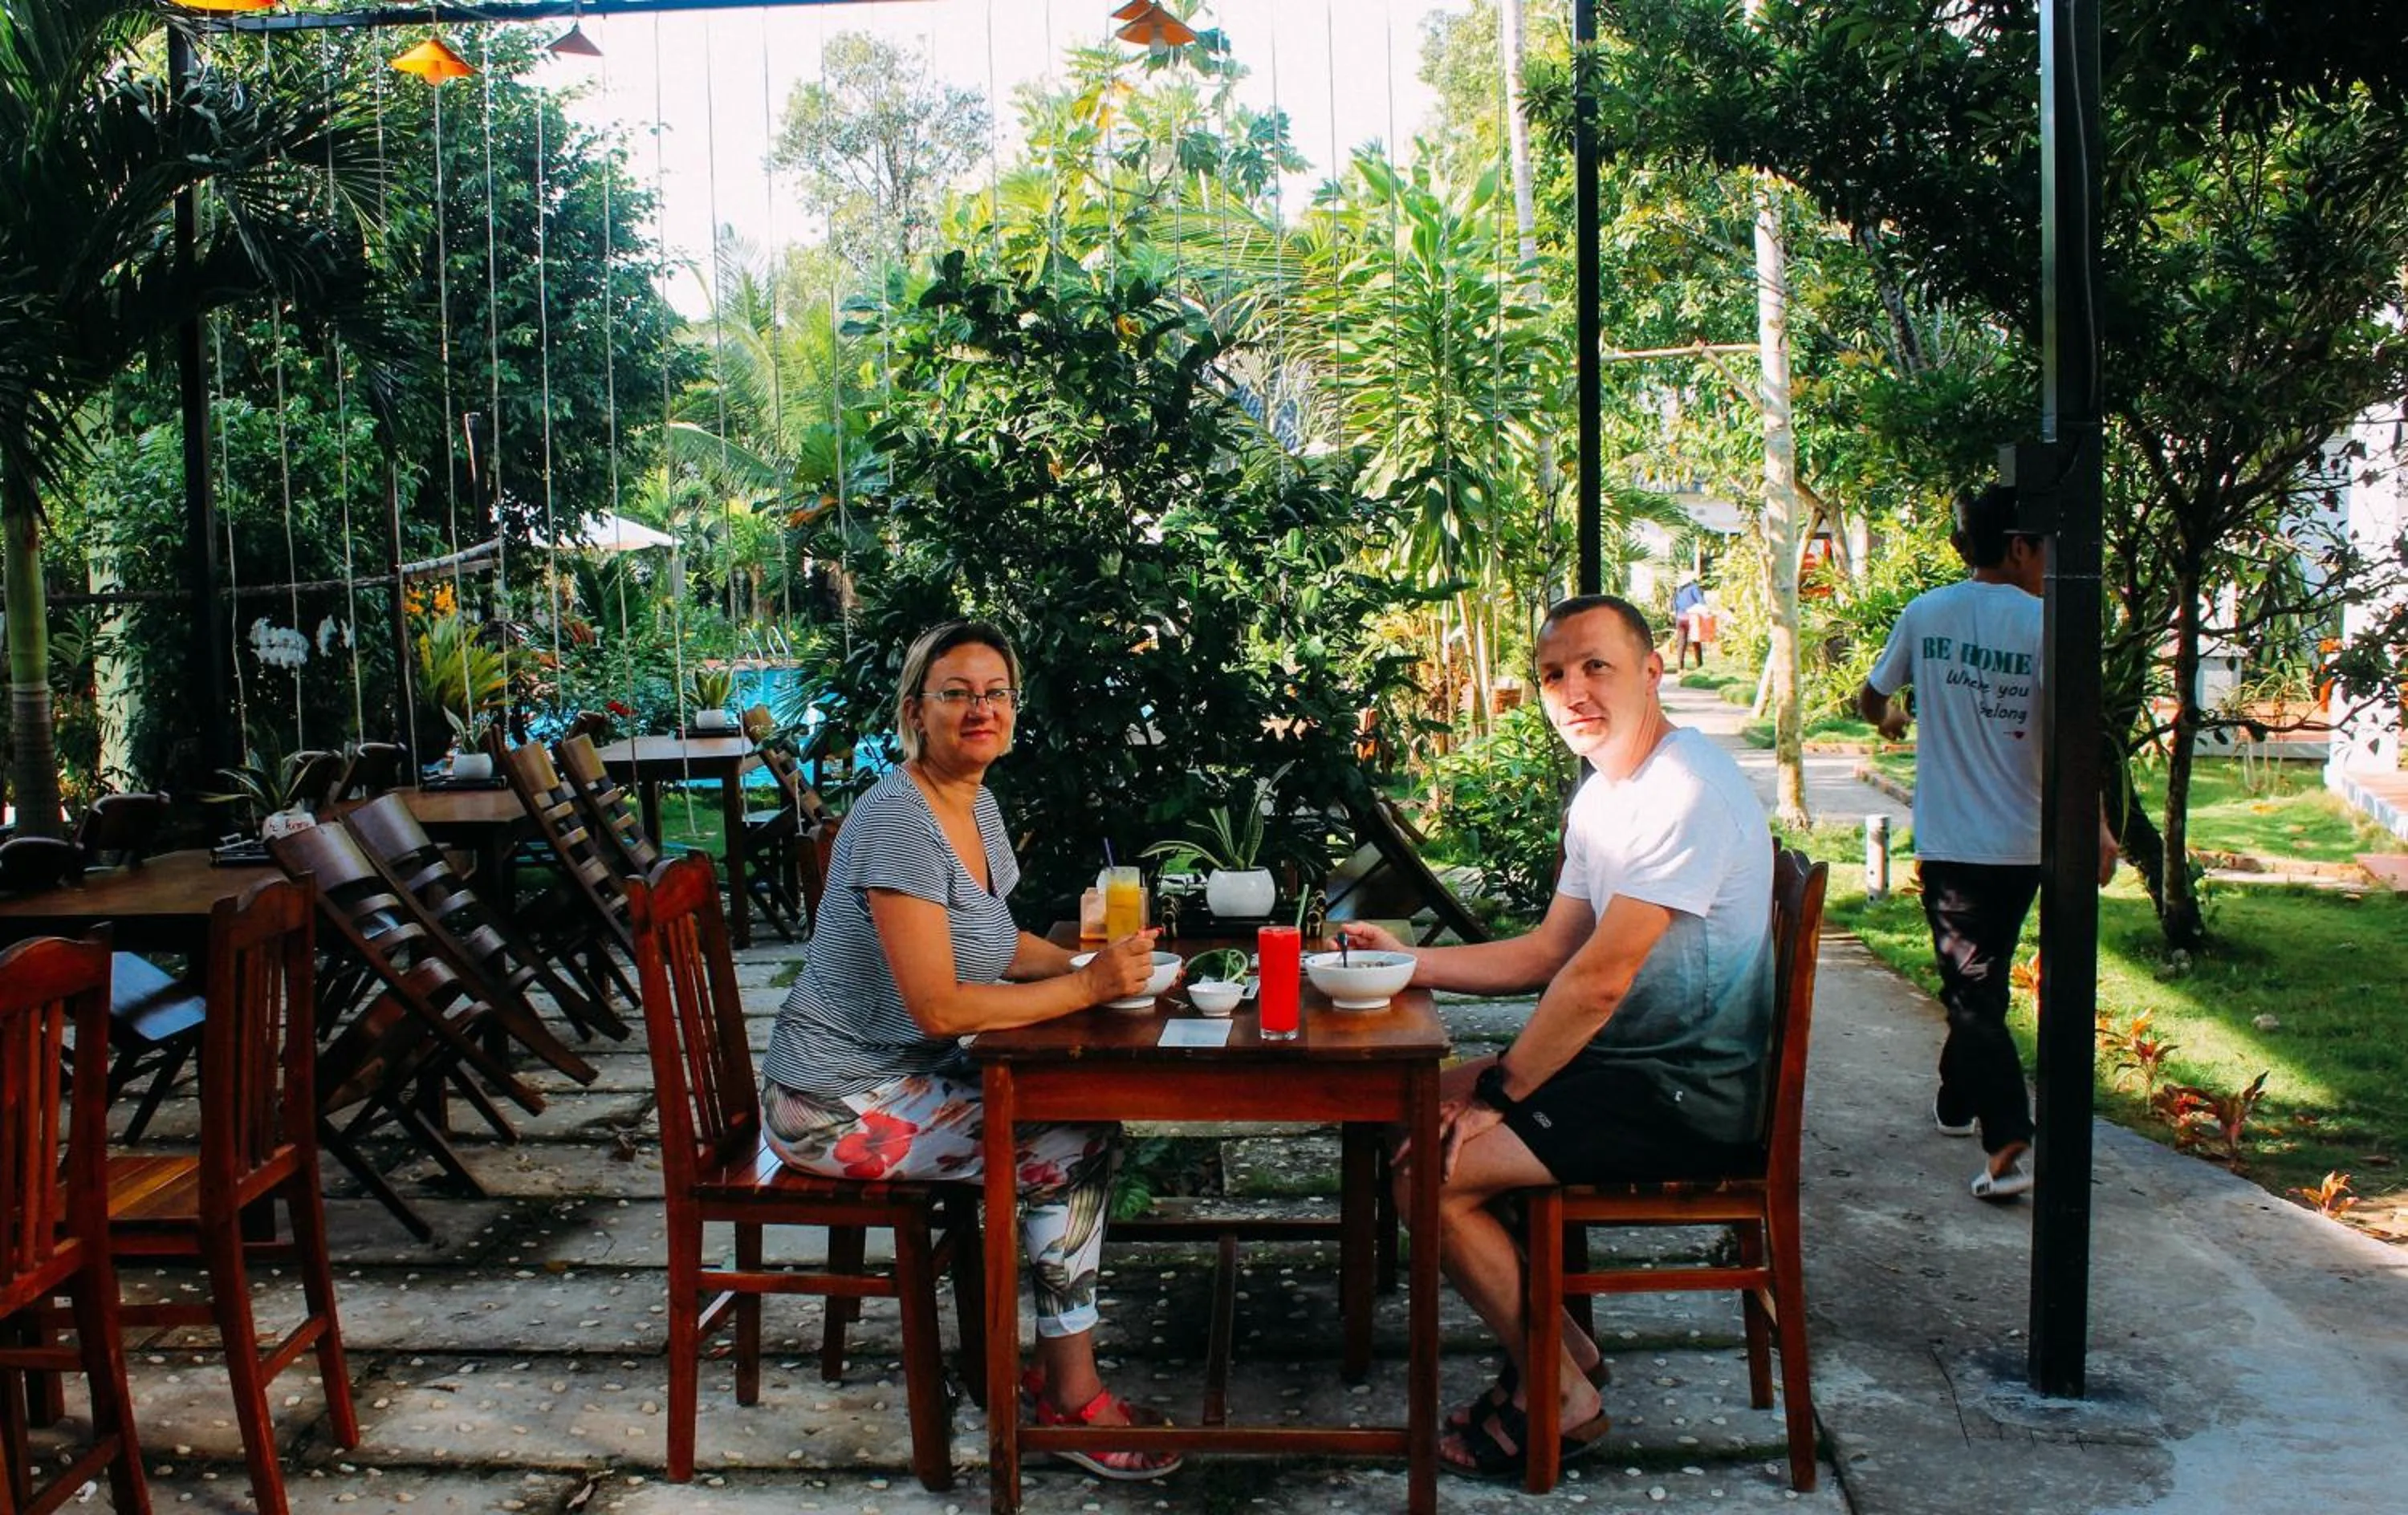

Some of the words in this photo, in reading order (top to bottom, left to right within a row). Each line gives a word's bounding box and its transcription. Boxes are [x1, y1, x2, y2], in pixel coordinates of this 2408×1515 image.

[1922, 636, 1952, 660] BE
[1961, 642, 2032, 675] HOME
[1946, 669, 1991, 693] Where
[1997, 685, 2029, 698] you
